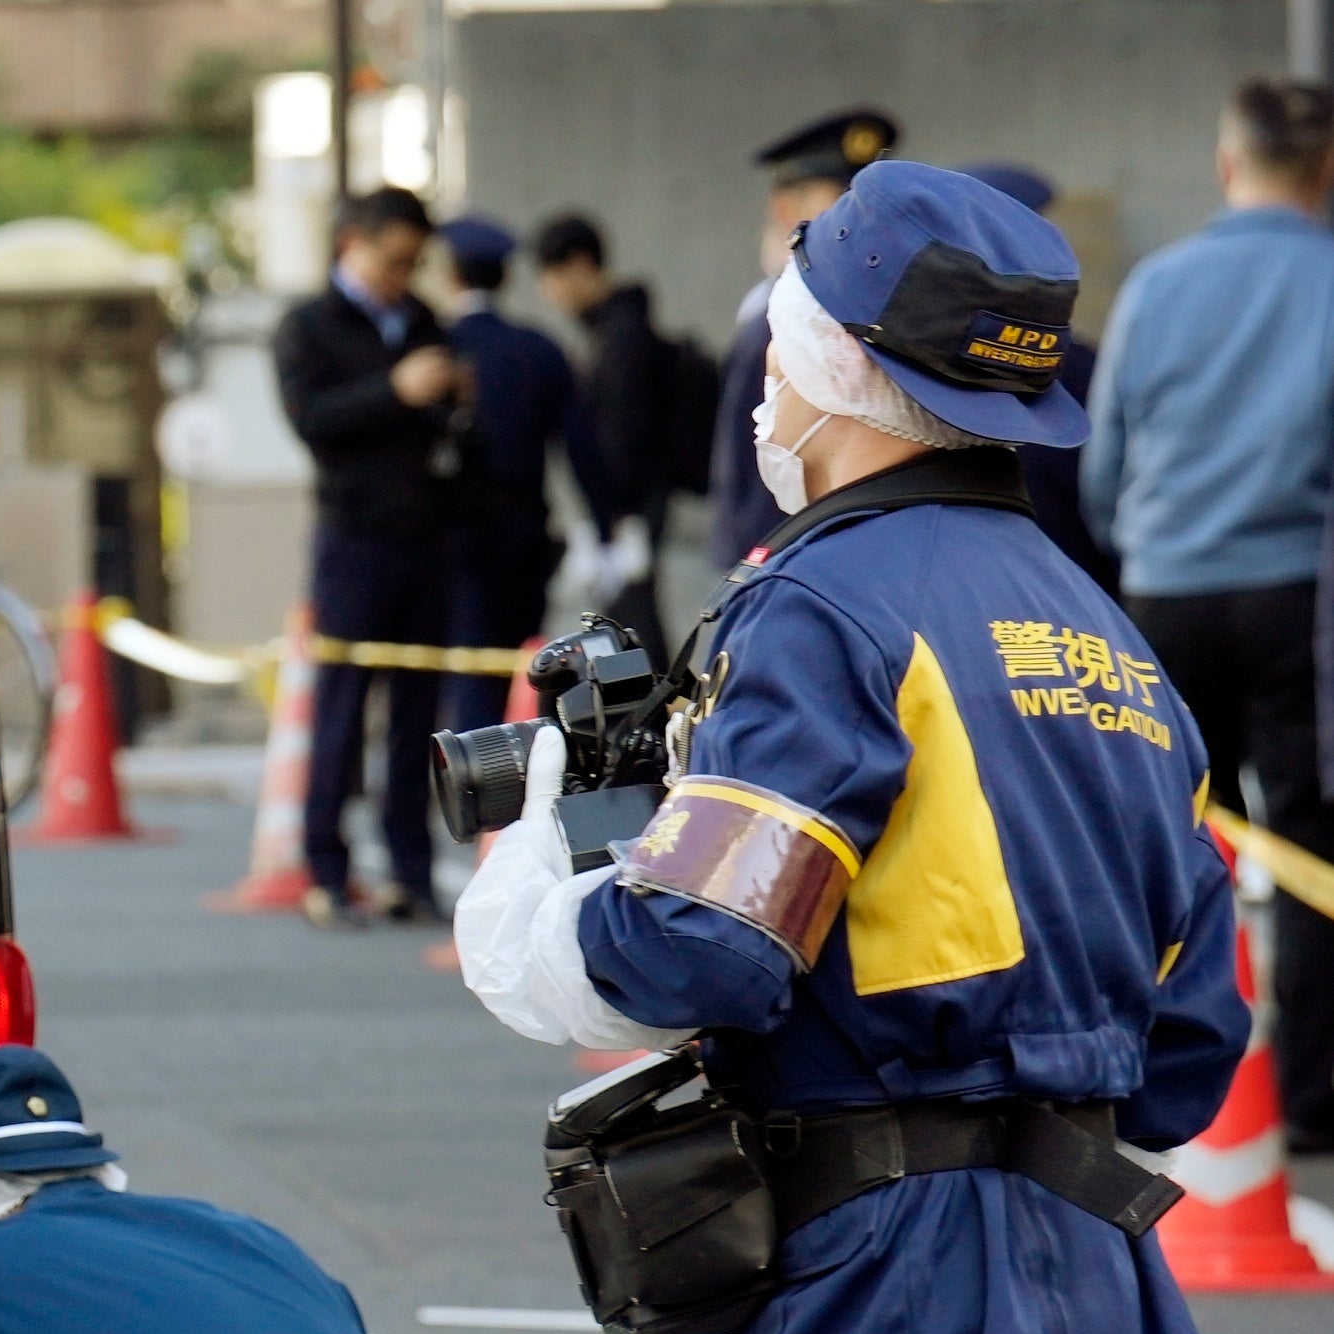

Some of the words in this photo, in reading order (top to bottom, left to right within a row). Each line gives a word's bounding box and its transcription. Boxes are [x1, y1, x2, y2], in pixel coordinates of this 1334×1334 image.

[997, 324, 1058, 350] MPD
[988, 620, 1161, 708] 警視庁
